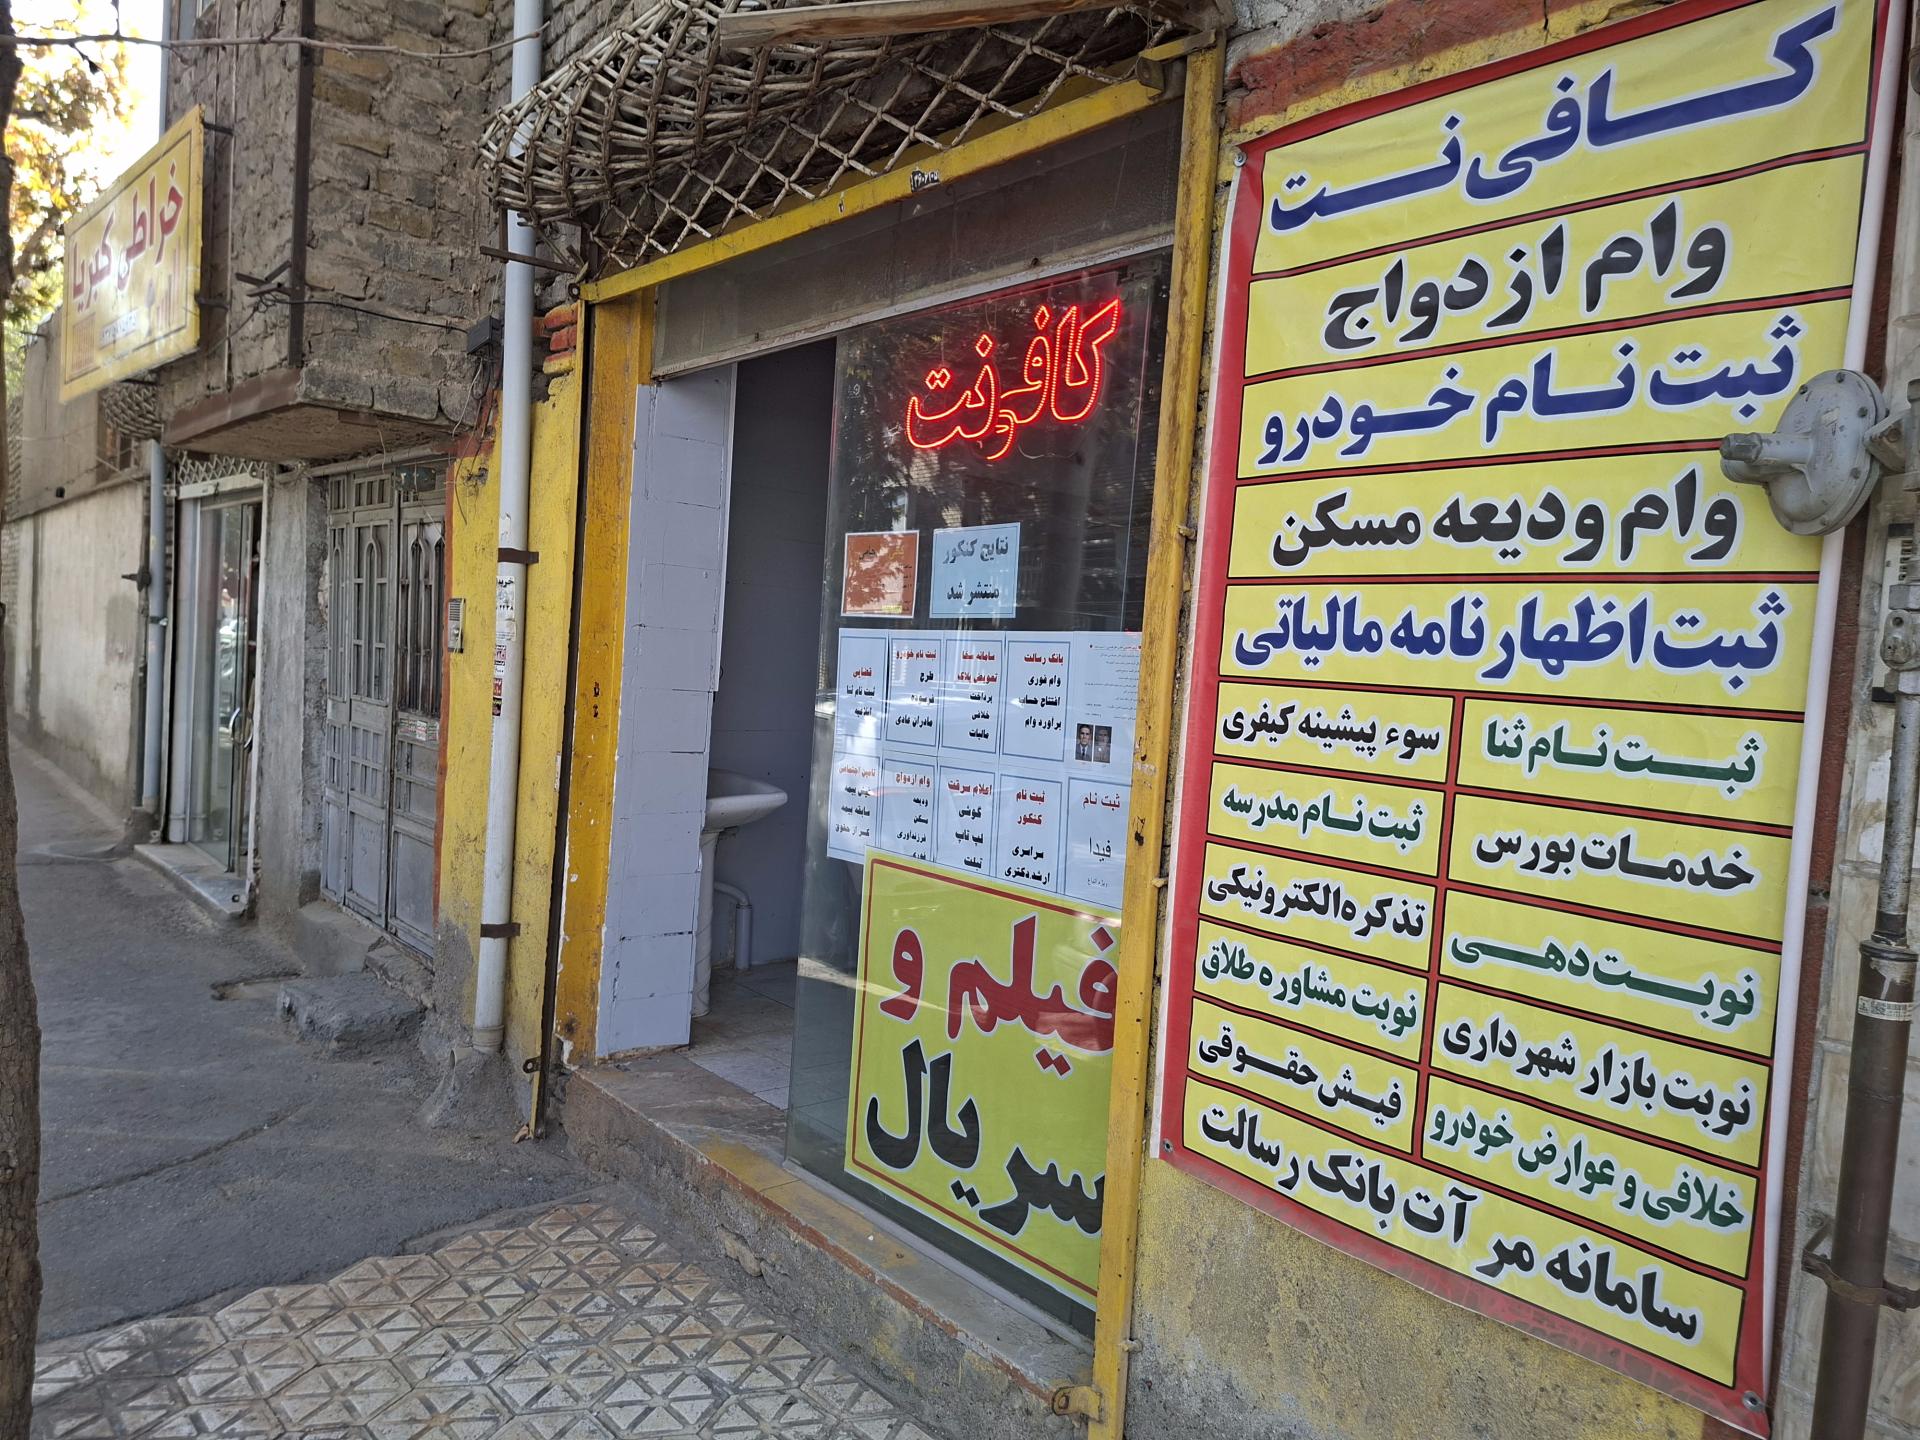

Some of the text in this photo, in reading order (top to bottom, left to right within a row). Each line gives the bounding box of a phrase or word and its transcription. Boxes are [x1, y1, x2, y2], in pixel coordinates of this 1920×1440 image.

[1271, 6, 1837, 232] کافی نت
[117, 161, 184, 290] خراطی
[1324, 202, 1727, 350] وام ازدواج
[905, 298, 1120, 460] کافی نت
[1257, 315, 1801, 466] ثبت نام خودرو
[1273, 468, 1738, 566] وام ودیعه مسکن
[942, 536, 1009, 564] نتایج کنکور
[947, 581, 1000, 605] منتشر شد
[915, 650, 924, 660] نام
[925, 650, 937, 661] ثبت
[1024, 653, 1064, 666] بانک رسالت
[1236, 596, 1383, 669] مالیاتی
[1653, 592, 1787, 689] ثبت
[854, 686, 862, 697] نام
[864, 686, 876, 698] ثبت
[920, 671, 934, 682] طرح
[1028, 675, 1061, 687] وام فوری
[969, 728, 989, 740] مالیات
[1025, 716, 1036, 728] وام
[1223, 703, 1440, 759] سوء پیشینه کیفری
[896, 772, 931, 788] وام ازدواج
[1487, 719, 1759, 794] ثبت نام ثنا
[948, 780, 992, 796] اعلام سرقت
[1016, 789, 1045, 805] ثبت نام
[1083, 792, 1120, 811] ثبت نام
[1017, 813, 1042, 825] کنکور
[1223, 788, 1423, 850] ثبت نام مدرسه
[964, 856, 983, 871] تبلت
[1012, 846, 1044, 860] سراسری
[1089, 837, 1111, 862] فیدا
[1476, 834, 1755, 890] خدمات بورس
[1207, 867, 1425, 936] تذکره الکترونیکی
[880, 915, 1119, 1078] فیلم و
[1202, 941, 1417, 1036] نوبت مشاوره طلاق
[1593, 954, 1755, 1027] نوبت
[1199, 1026, 1401, 1126] فیش حقوقی
[1443, 1017, 1750, 1136] نوبت بازار شهرداری
[867, 1039, 1106, 1236] سریال
[1202, 1108, 1299, 1190] رسالت
[1308, 1154, 1395, 1230] بانک
[1430, 1110, 1744, 1227] خلافی و عوارض خودرو
[1545, 1243, 1697, 1340] سامانه
